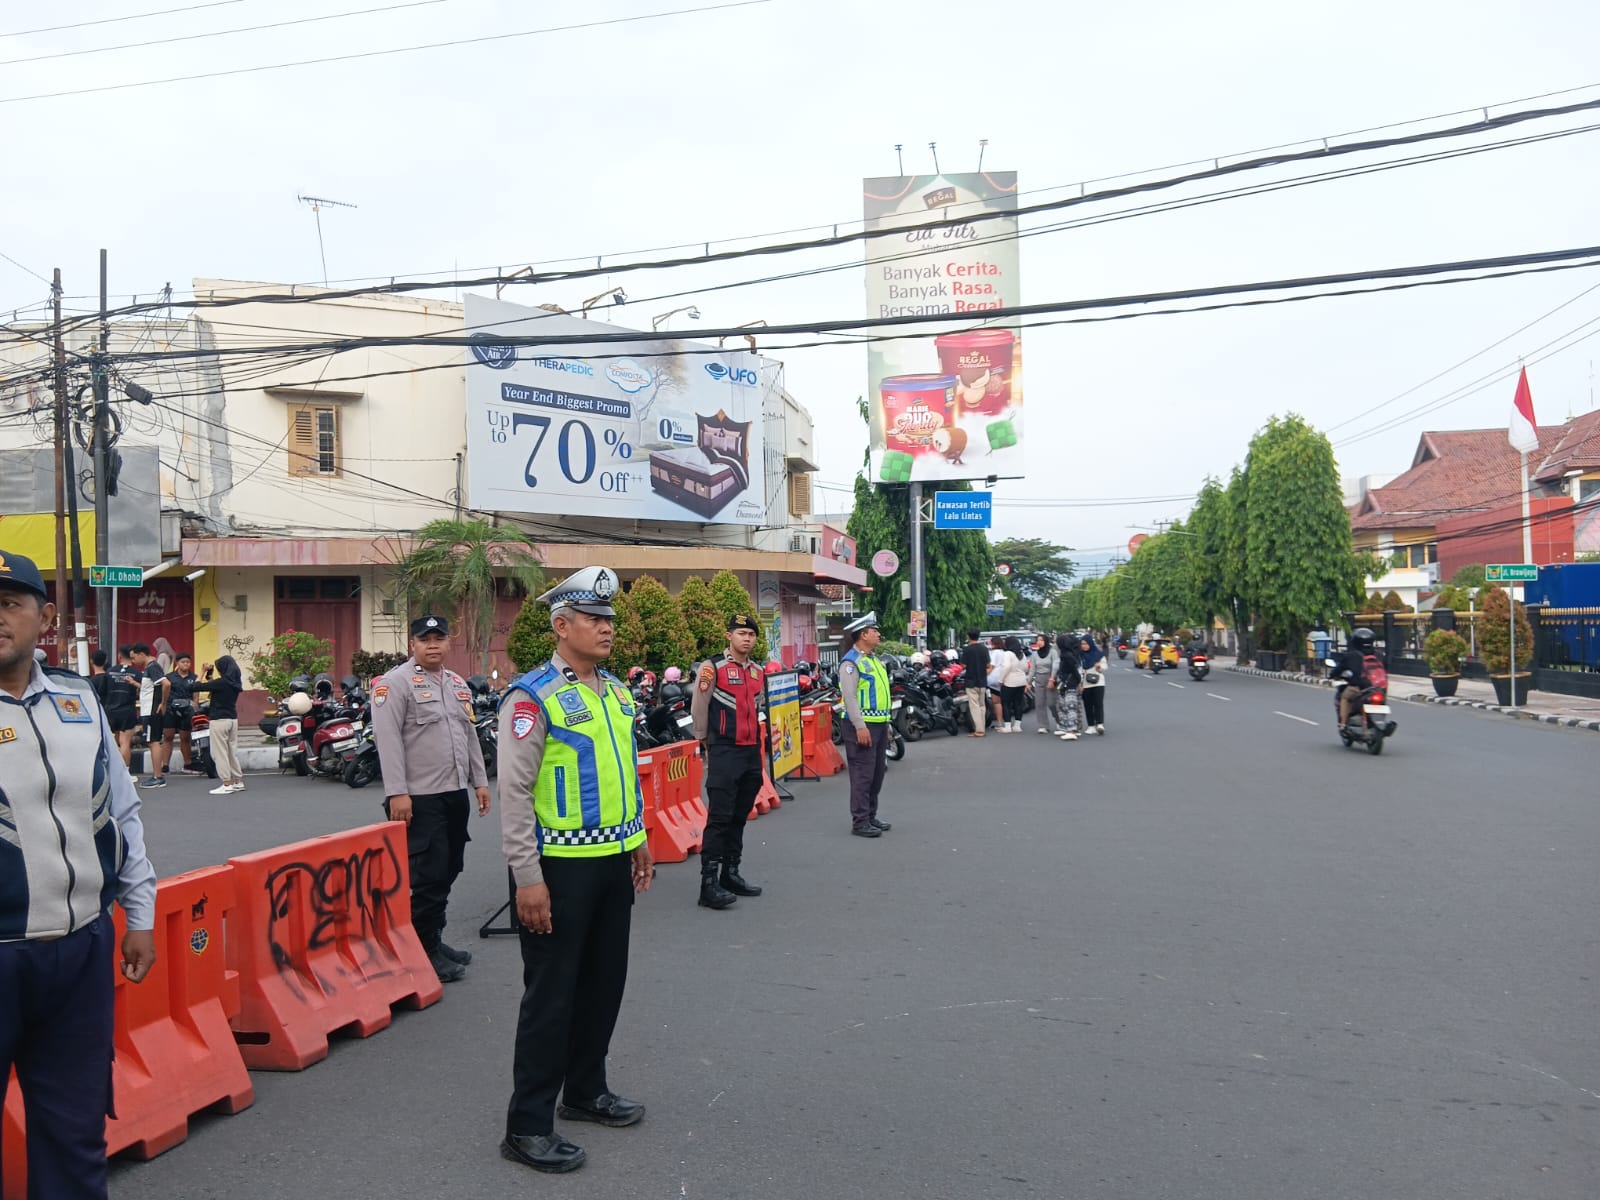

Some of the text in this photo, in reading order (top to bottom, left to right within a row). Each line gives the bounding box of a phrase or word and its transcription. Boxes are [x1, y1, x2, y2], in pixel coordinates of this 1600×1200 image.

[883, 263, 942, 282] Banyak
[889, 282, 948, 301] Banyak
[880, 303, 950, 319] Bersama
[533, 359, 594, 377] THERAPEDIC
[959, 355, 991, 364] REGAL
[728, 366, 758, 385] UFO
[504, 386, 629, 415] Year End Biggest Promo
[487, 410, 511, 431] Up
[491, 427, 507, 444] to
[937, 500, 991, 509] Kawasan Tertib
[944, 511, 983, 520] Lalu Lintas
[118, 572, 141, 582] Dhoho
[567, 713, 590, 724] SODIK
